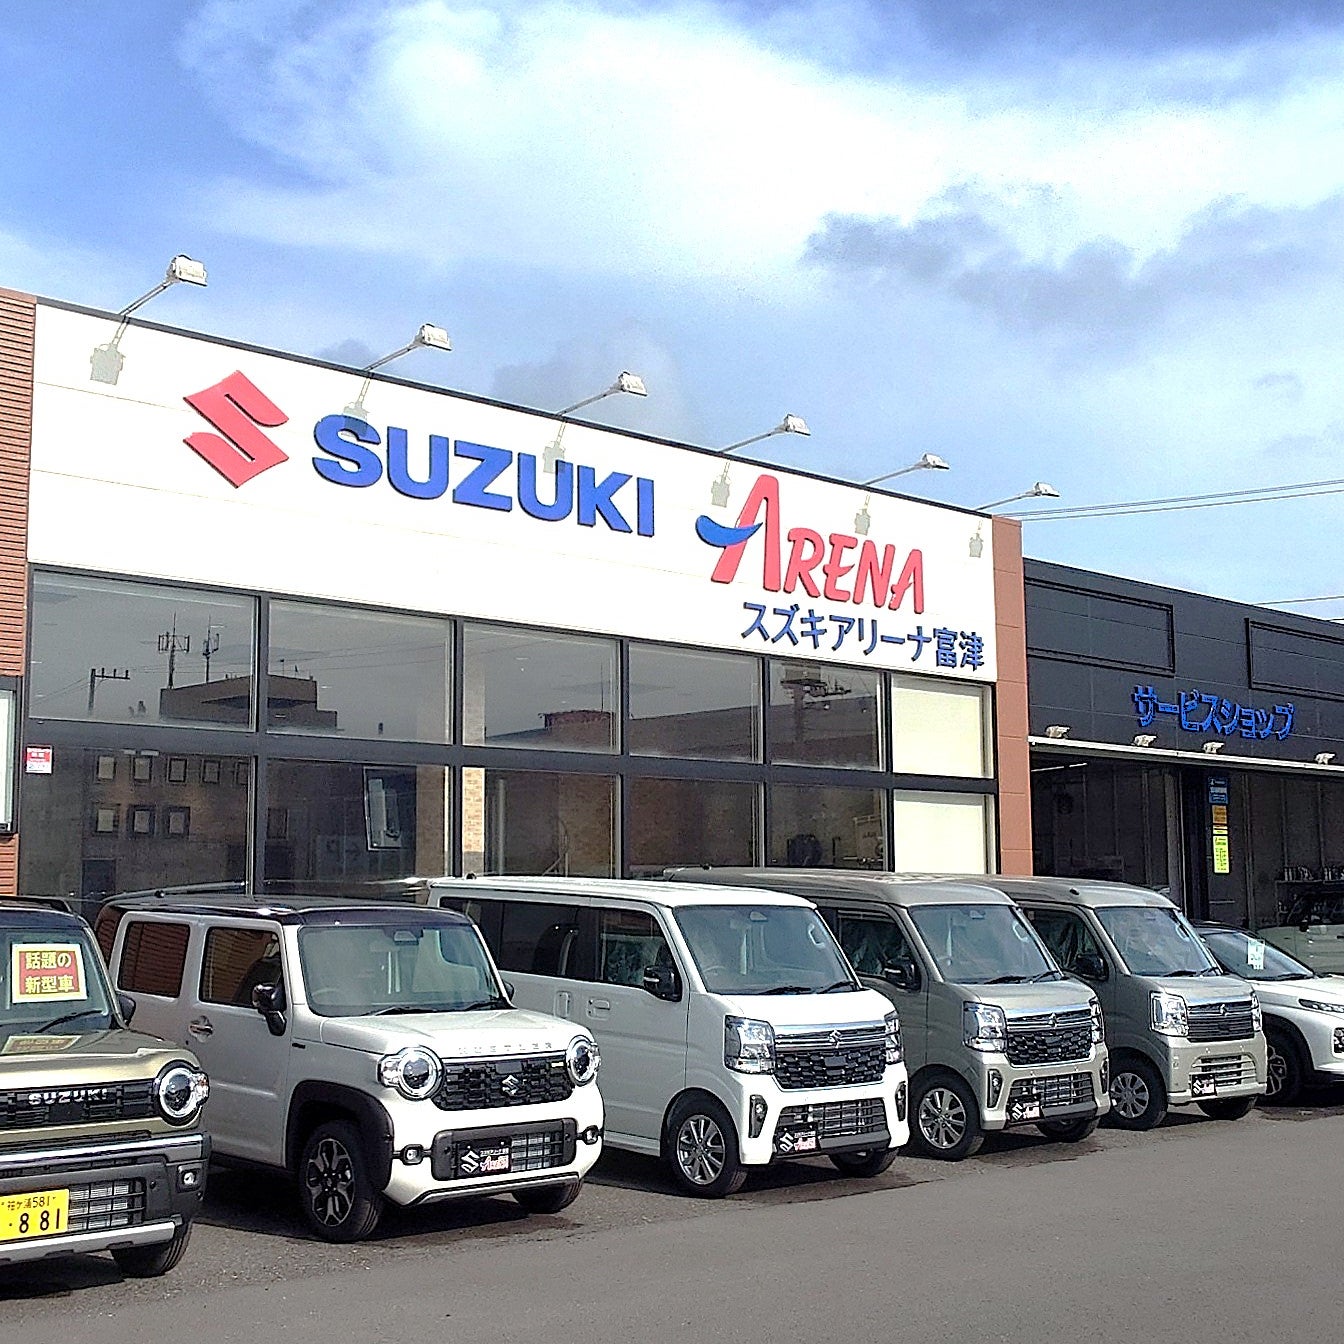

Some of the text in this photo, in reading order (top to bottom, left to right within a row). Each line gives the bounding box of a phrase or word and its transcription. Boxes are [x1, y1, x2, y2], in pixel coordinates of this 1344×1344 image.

[312, 414, 925, 614] SUZUKI ARENA
[741, 601, 985, 671] スズキアリーナ富津
[1131, 684, 1295, 741] サービスショップ
[25, 952, 72, 969] 話題の
[25, 975, 74, 994] 新型車
[28, 1088, 108, 1106] SUZUKI
